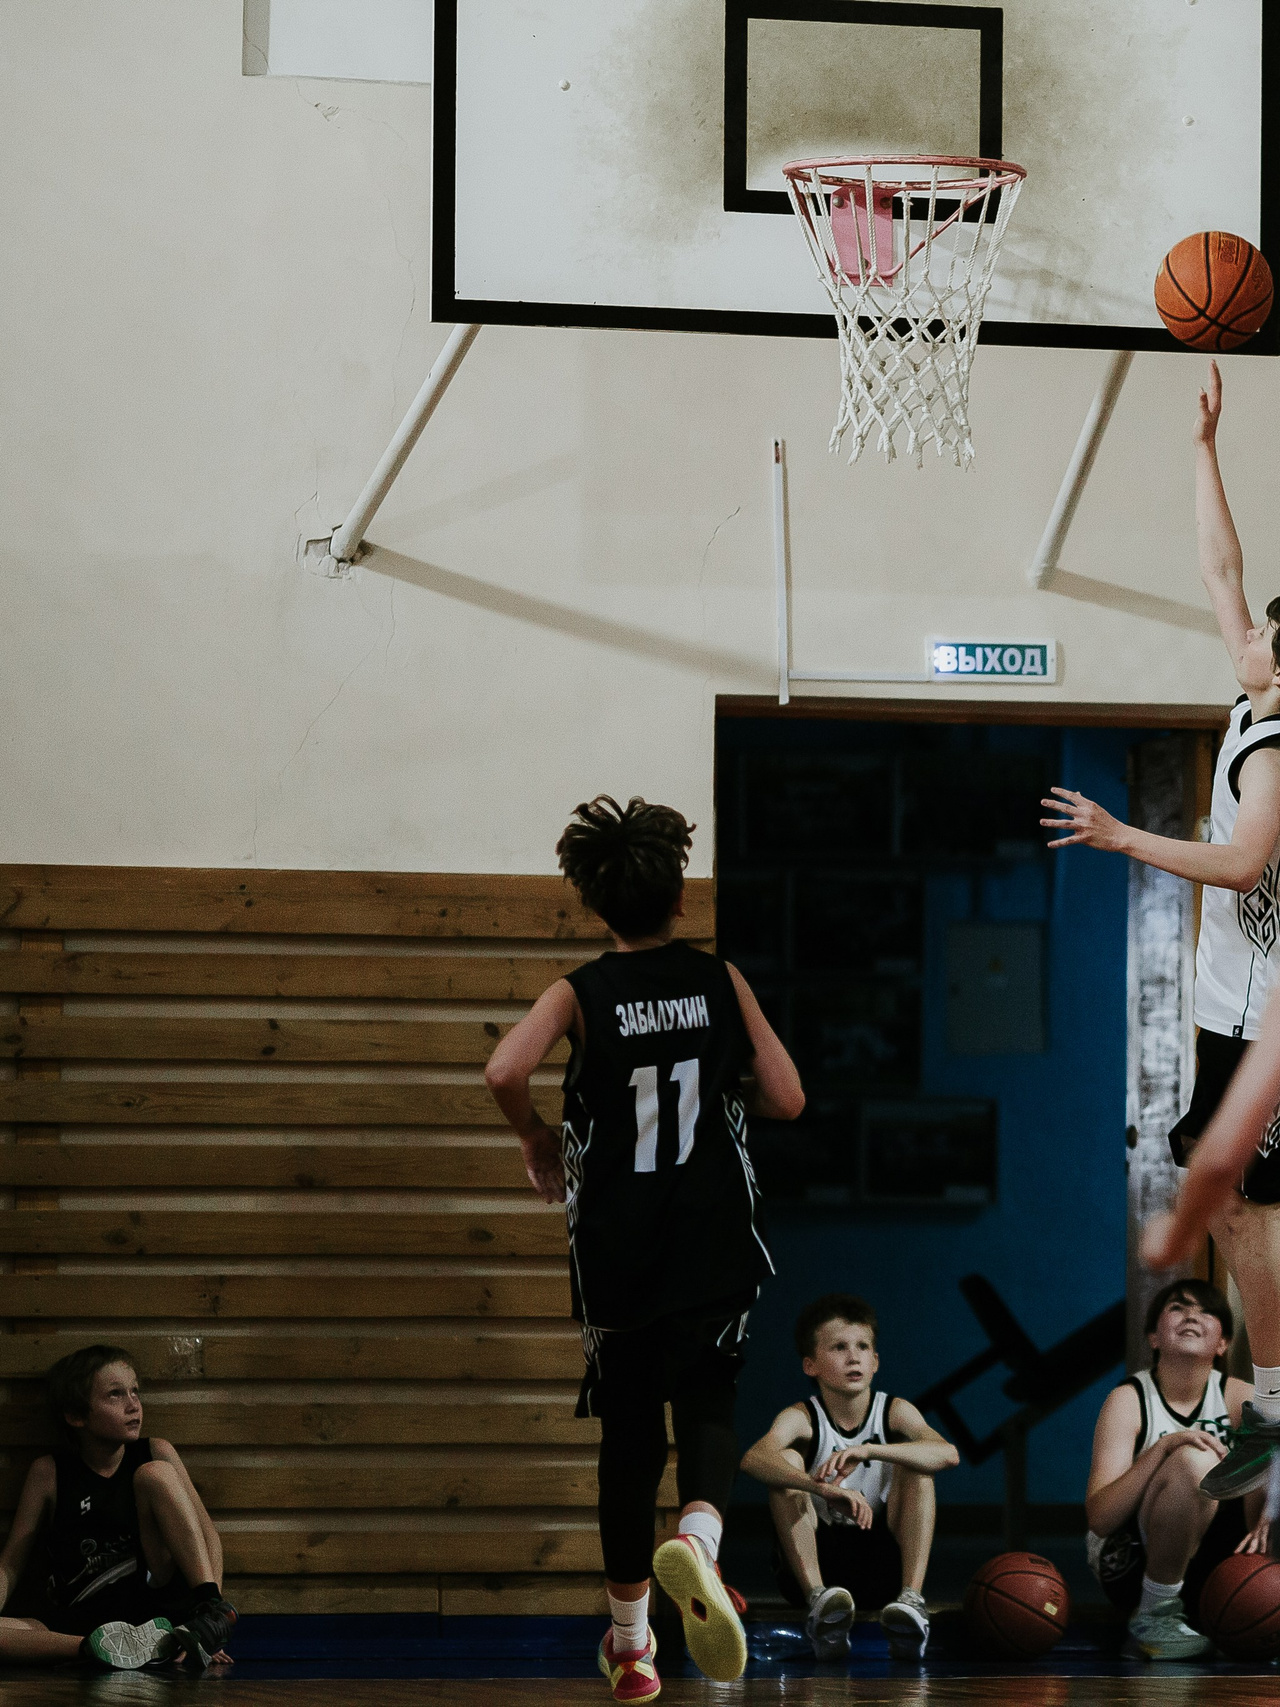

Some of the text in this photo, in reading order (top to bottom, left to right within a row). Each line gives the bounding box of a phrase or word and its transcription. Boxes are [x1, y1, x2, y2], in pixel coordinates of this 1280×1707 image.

[935, 645, 1043, 675] ВЫХОД
[616, 995, 710, 1036] ЗАБАЛУХИН
[628, 1058, 700, 1172] 11
